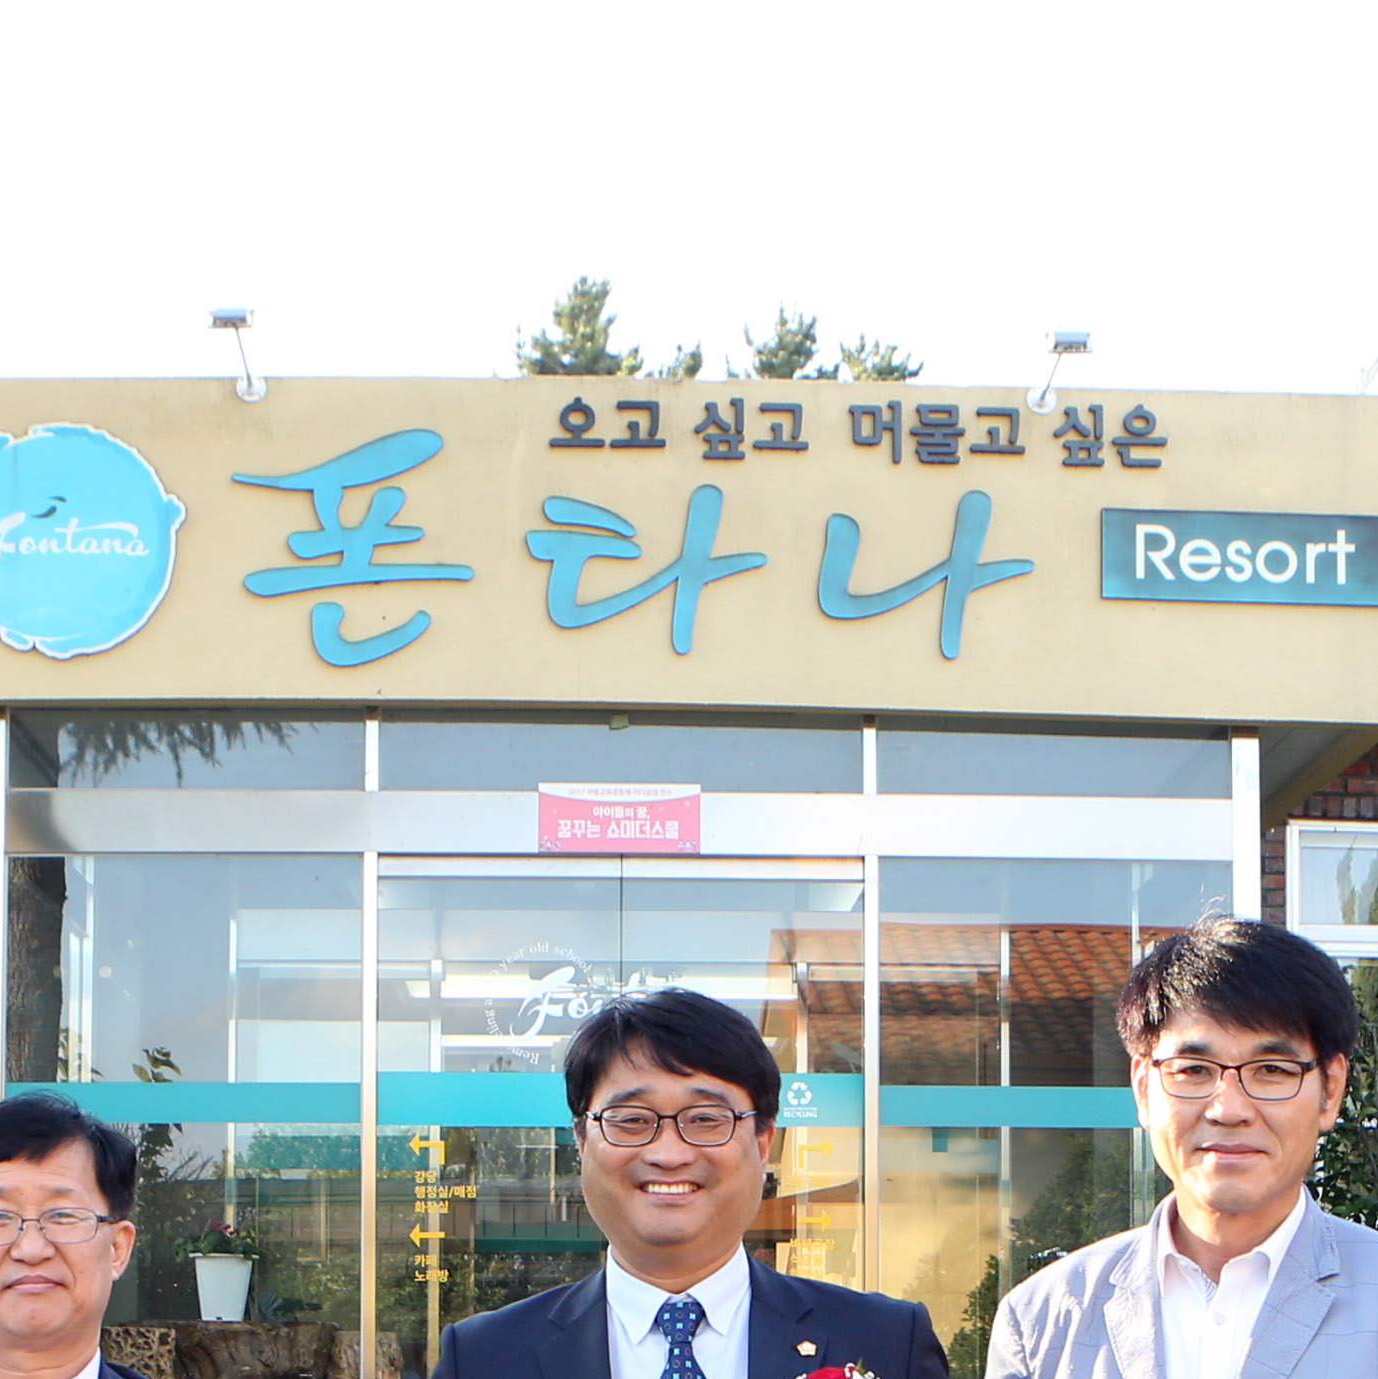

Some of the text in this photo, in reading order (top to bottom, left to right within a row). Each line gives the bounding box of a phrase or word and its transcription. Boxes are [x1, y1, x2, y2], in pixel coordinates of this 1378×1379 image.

[549, 397, 1168, 469] 오고 싶고 머물고 싶은
[232, 428, 1036, 668] 폰타나
[1135, 523, 1356, 585] Resort
[593, 805, 634, 818] 아이들의
[557, 819, 679, 839] 꿈꾸는 쇼미더스쿨
[529, 941, 550, 954] old
[553, 945, 592, 974] school
[414, 1170, 437, 1183] 강당
[414, 1185, 477, 1198] 행정실/매점
[414, 1200, 449, 1214] 화장실
[414, 1254, 437, 1267] 카페
[414, 1269, 449, 1283] 노래방
